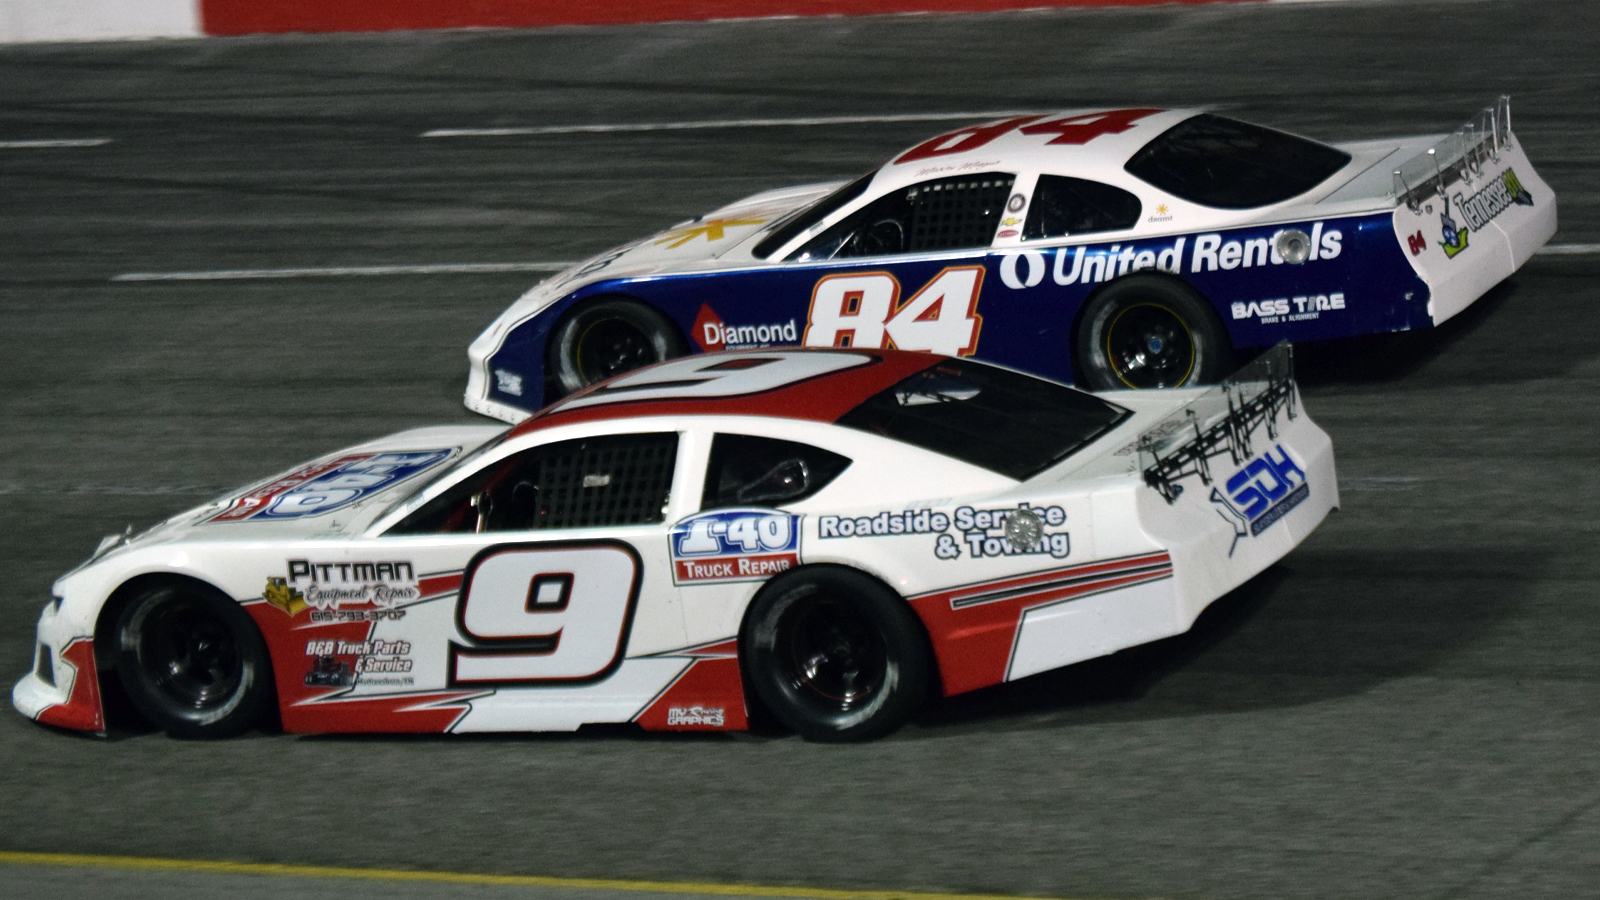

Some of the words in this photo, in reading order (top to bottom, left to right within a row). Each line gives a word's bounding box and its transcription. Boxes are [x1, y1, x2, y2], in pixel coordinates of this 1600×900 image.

[1052, 237, 1187, 287] United
[1191, 221, 1343, 273] Rentls
[1407, 230, 1427, 256] 84
[802, 265, 986, 357] 84
[1231, 298, 1290, 320] BASS
[1292, 292, 1346, 312] TIRE
[1261, 315, 1280, 325] BRAKE
[1288, 312, 1320, 322] ALIGNMENT
[703, 319, 797, 345] Diamond
[546, 350, 880, 415] 9
[818, 508, 951, 540] Roadside
[954, 502, 1067, 532] Serce
[678, 514, 791, 556] I-40
[934, 533, 962, 560] &
[964, 531, 1070, 560] Towng
[286, 558, 416, 584] PITTMAN
[682, 561, 734, 578] TRUCK
[737, 557, 791, 576] REPAIR
[306, 584, 370, 608] Equipment
[372, 582, 415, 607] Repair
[446, 537, 645, 690] 9
[305, 639, 335, 657] B&B
[336, 640, 372, 656] Truck
[372, 638, 412, 656] Parts
[354, 657, 366, 676] &
[364, 656, 413, 674] Service
